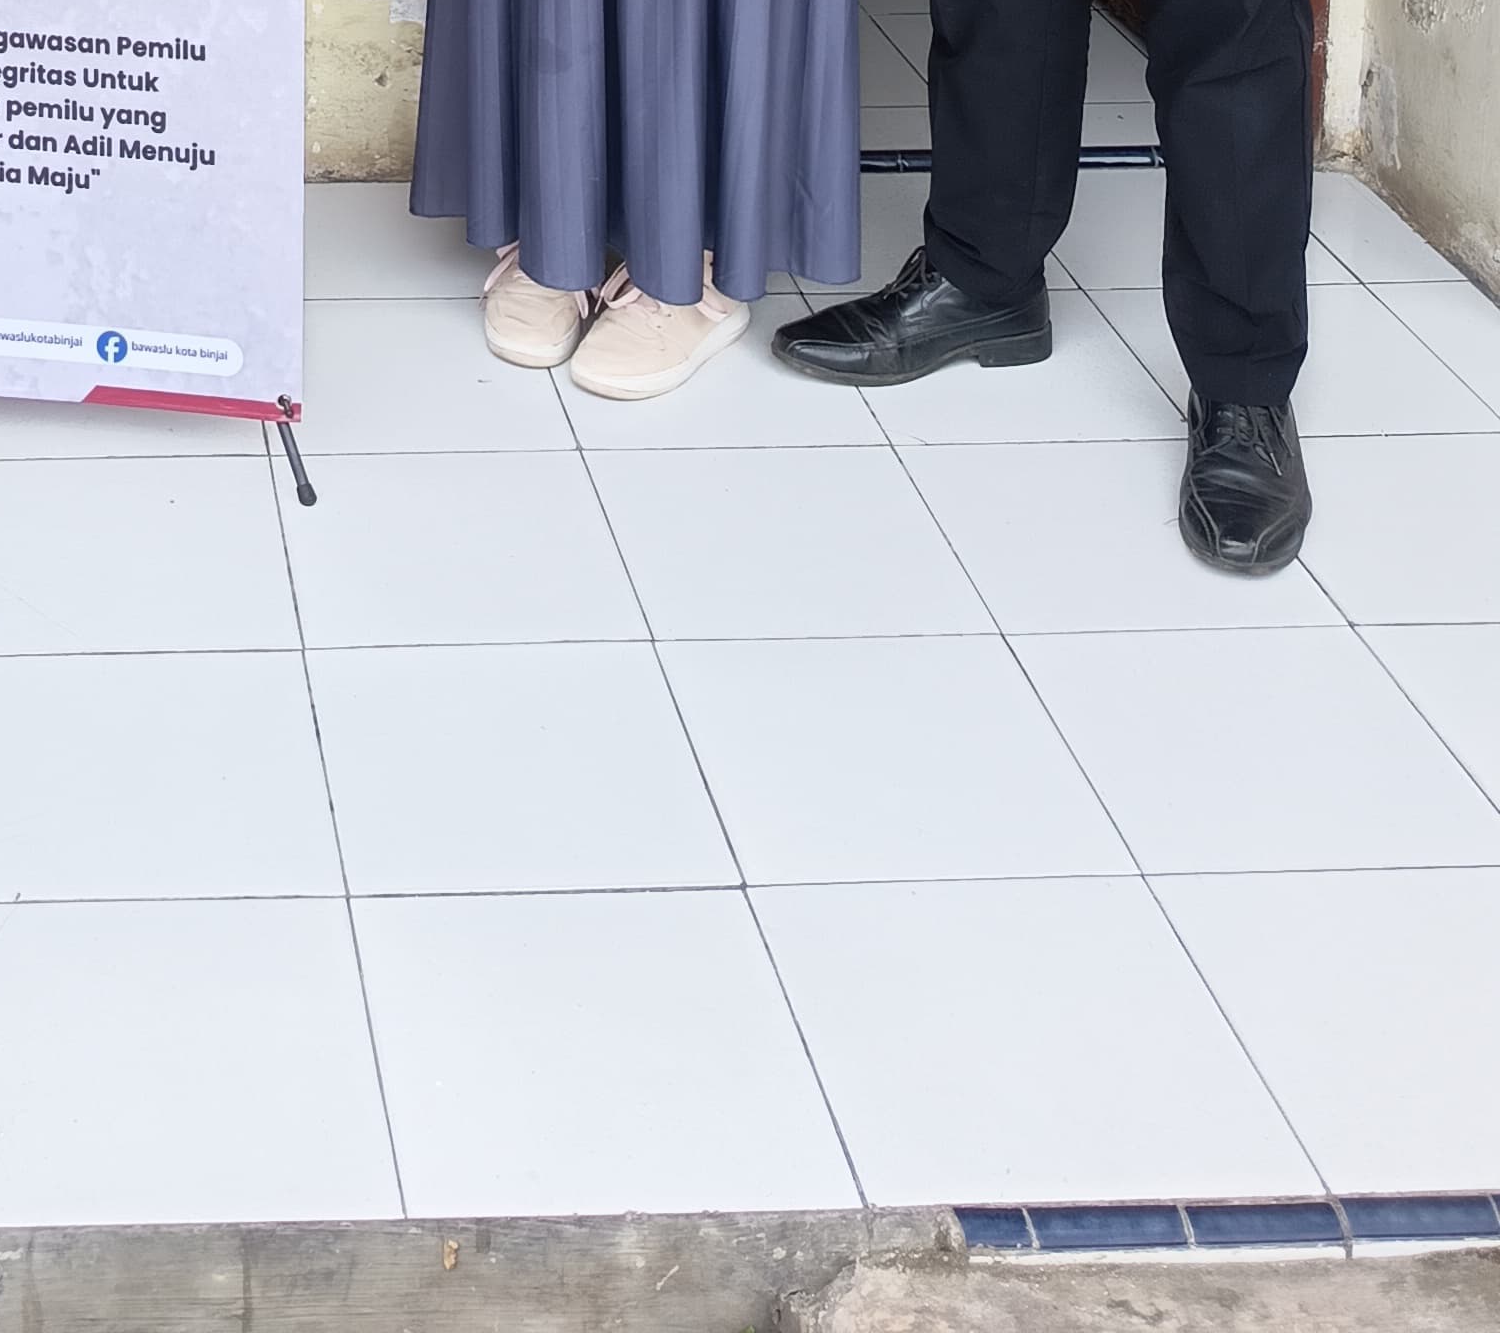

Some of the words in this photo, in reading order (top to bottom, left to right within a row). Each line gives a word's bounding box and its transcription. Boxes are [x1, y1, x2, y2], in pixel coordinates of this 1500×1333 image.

[117, 36, 206, 62] Pemilu
[83, 67, 159, 93] Untuk
[6, 97, 94, 123] pemilu
[100, 105, 167, 134] yang
[8, 130, 58, 153] dan
[63, 135, 113, 158] Adil
[119, 139, 216, 171] Menuju
[28, 165, 100, 195] Maju"
[131, 341, 173, 355] bawaslu
[175, 345, 197, 358] kota
[199, 348, 228, 361] binjai
